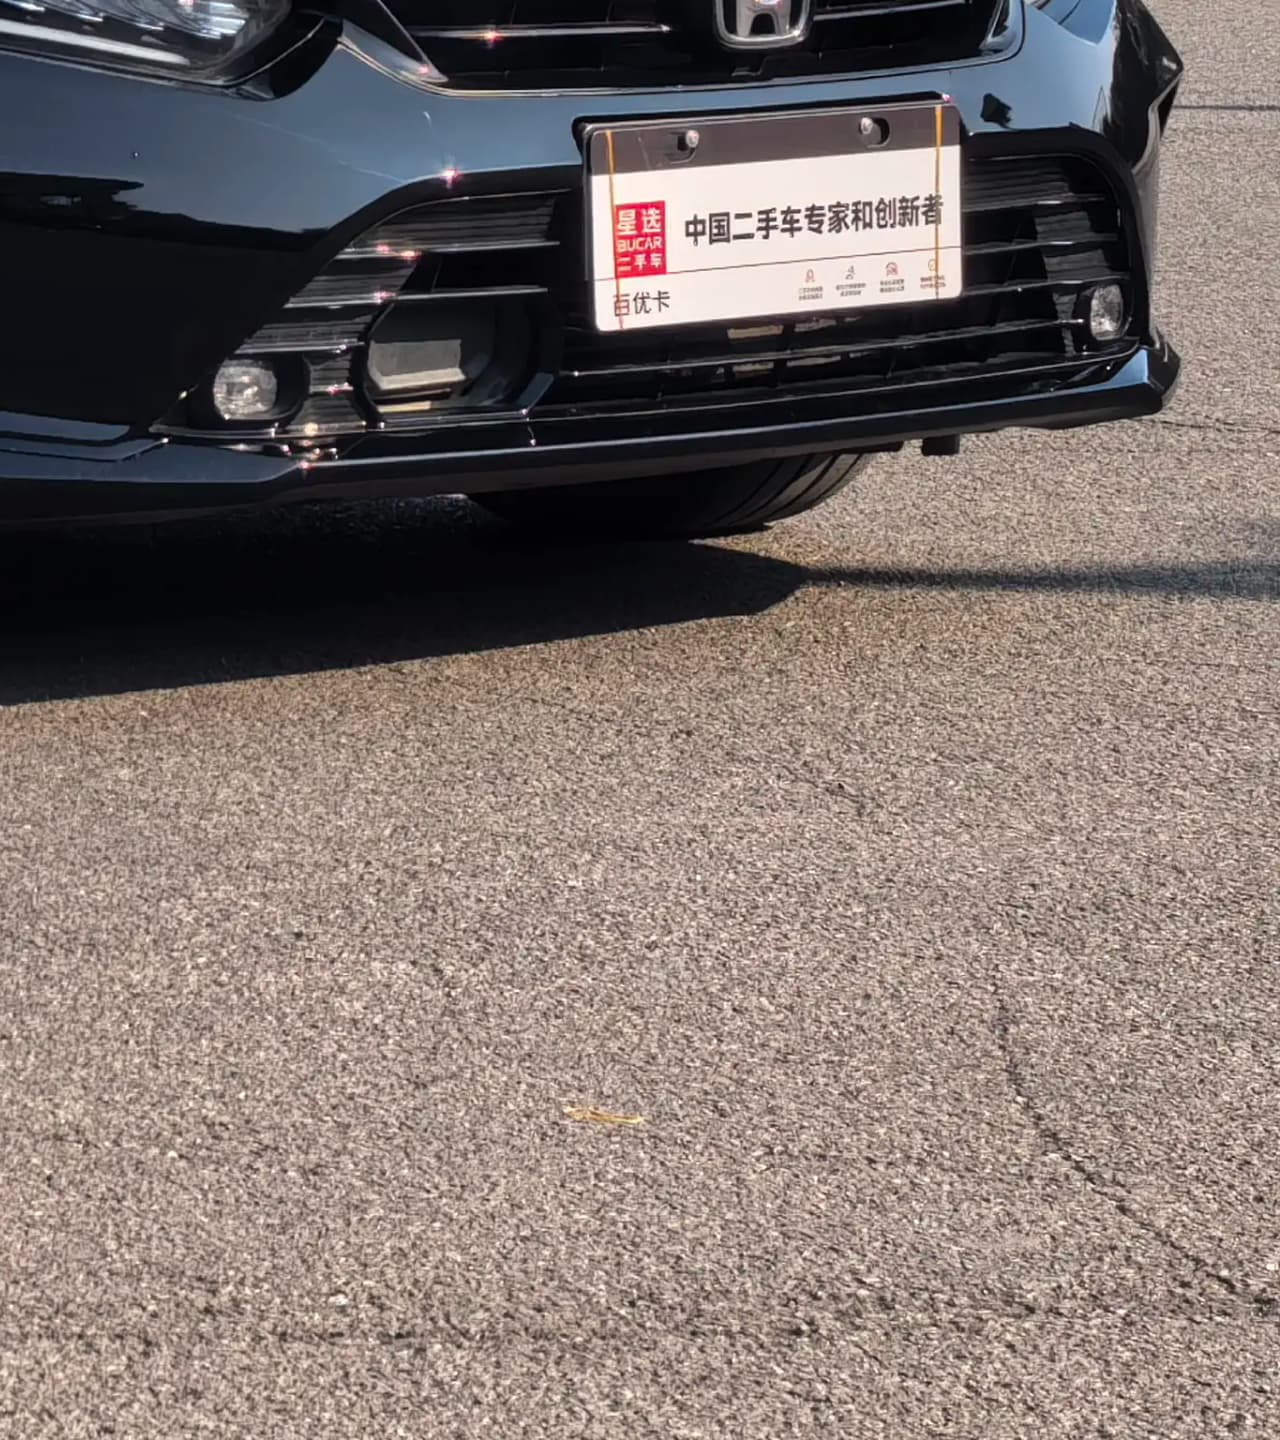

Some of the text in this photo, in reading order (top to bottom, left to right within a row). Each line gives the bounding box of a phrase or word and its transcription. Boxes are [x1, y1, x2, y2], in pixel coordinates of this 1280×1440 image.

[616, 207, 662, 235] 星选
[684, 194, 944, 247] 中国二手车专家和创新者
[617, 236, 663, 252] BUCAR
[617, 253, 663, 272] 二手车
[613, 290, 671, 317] 百优卡
